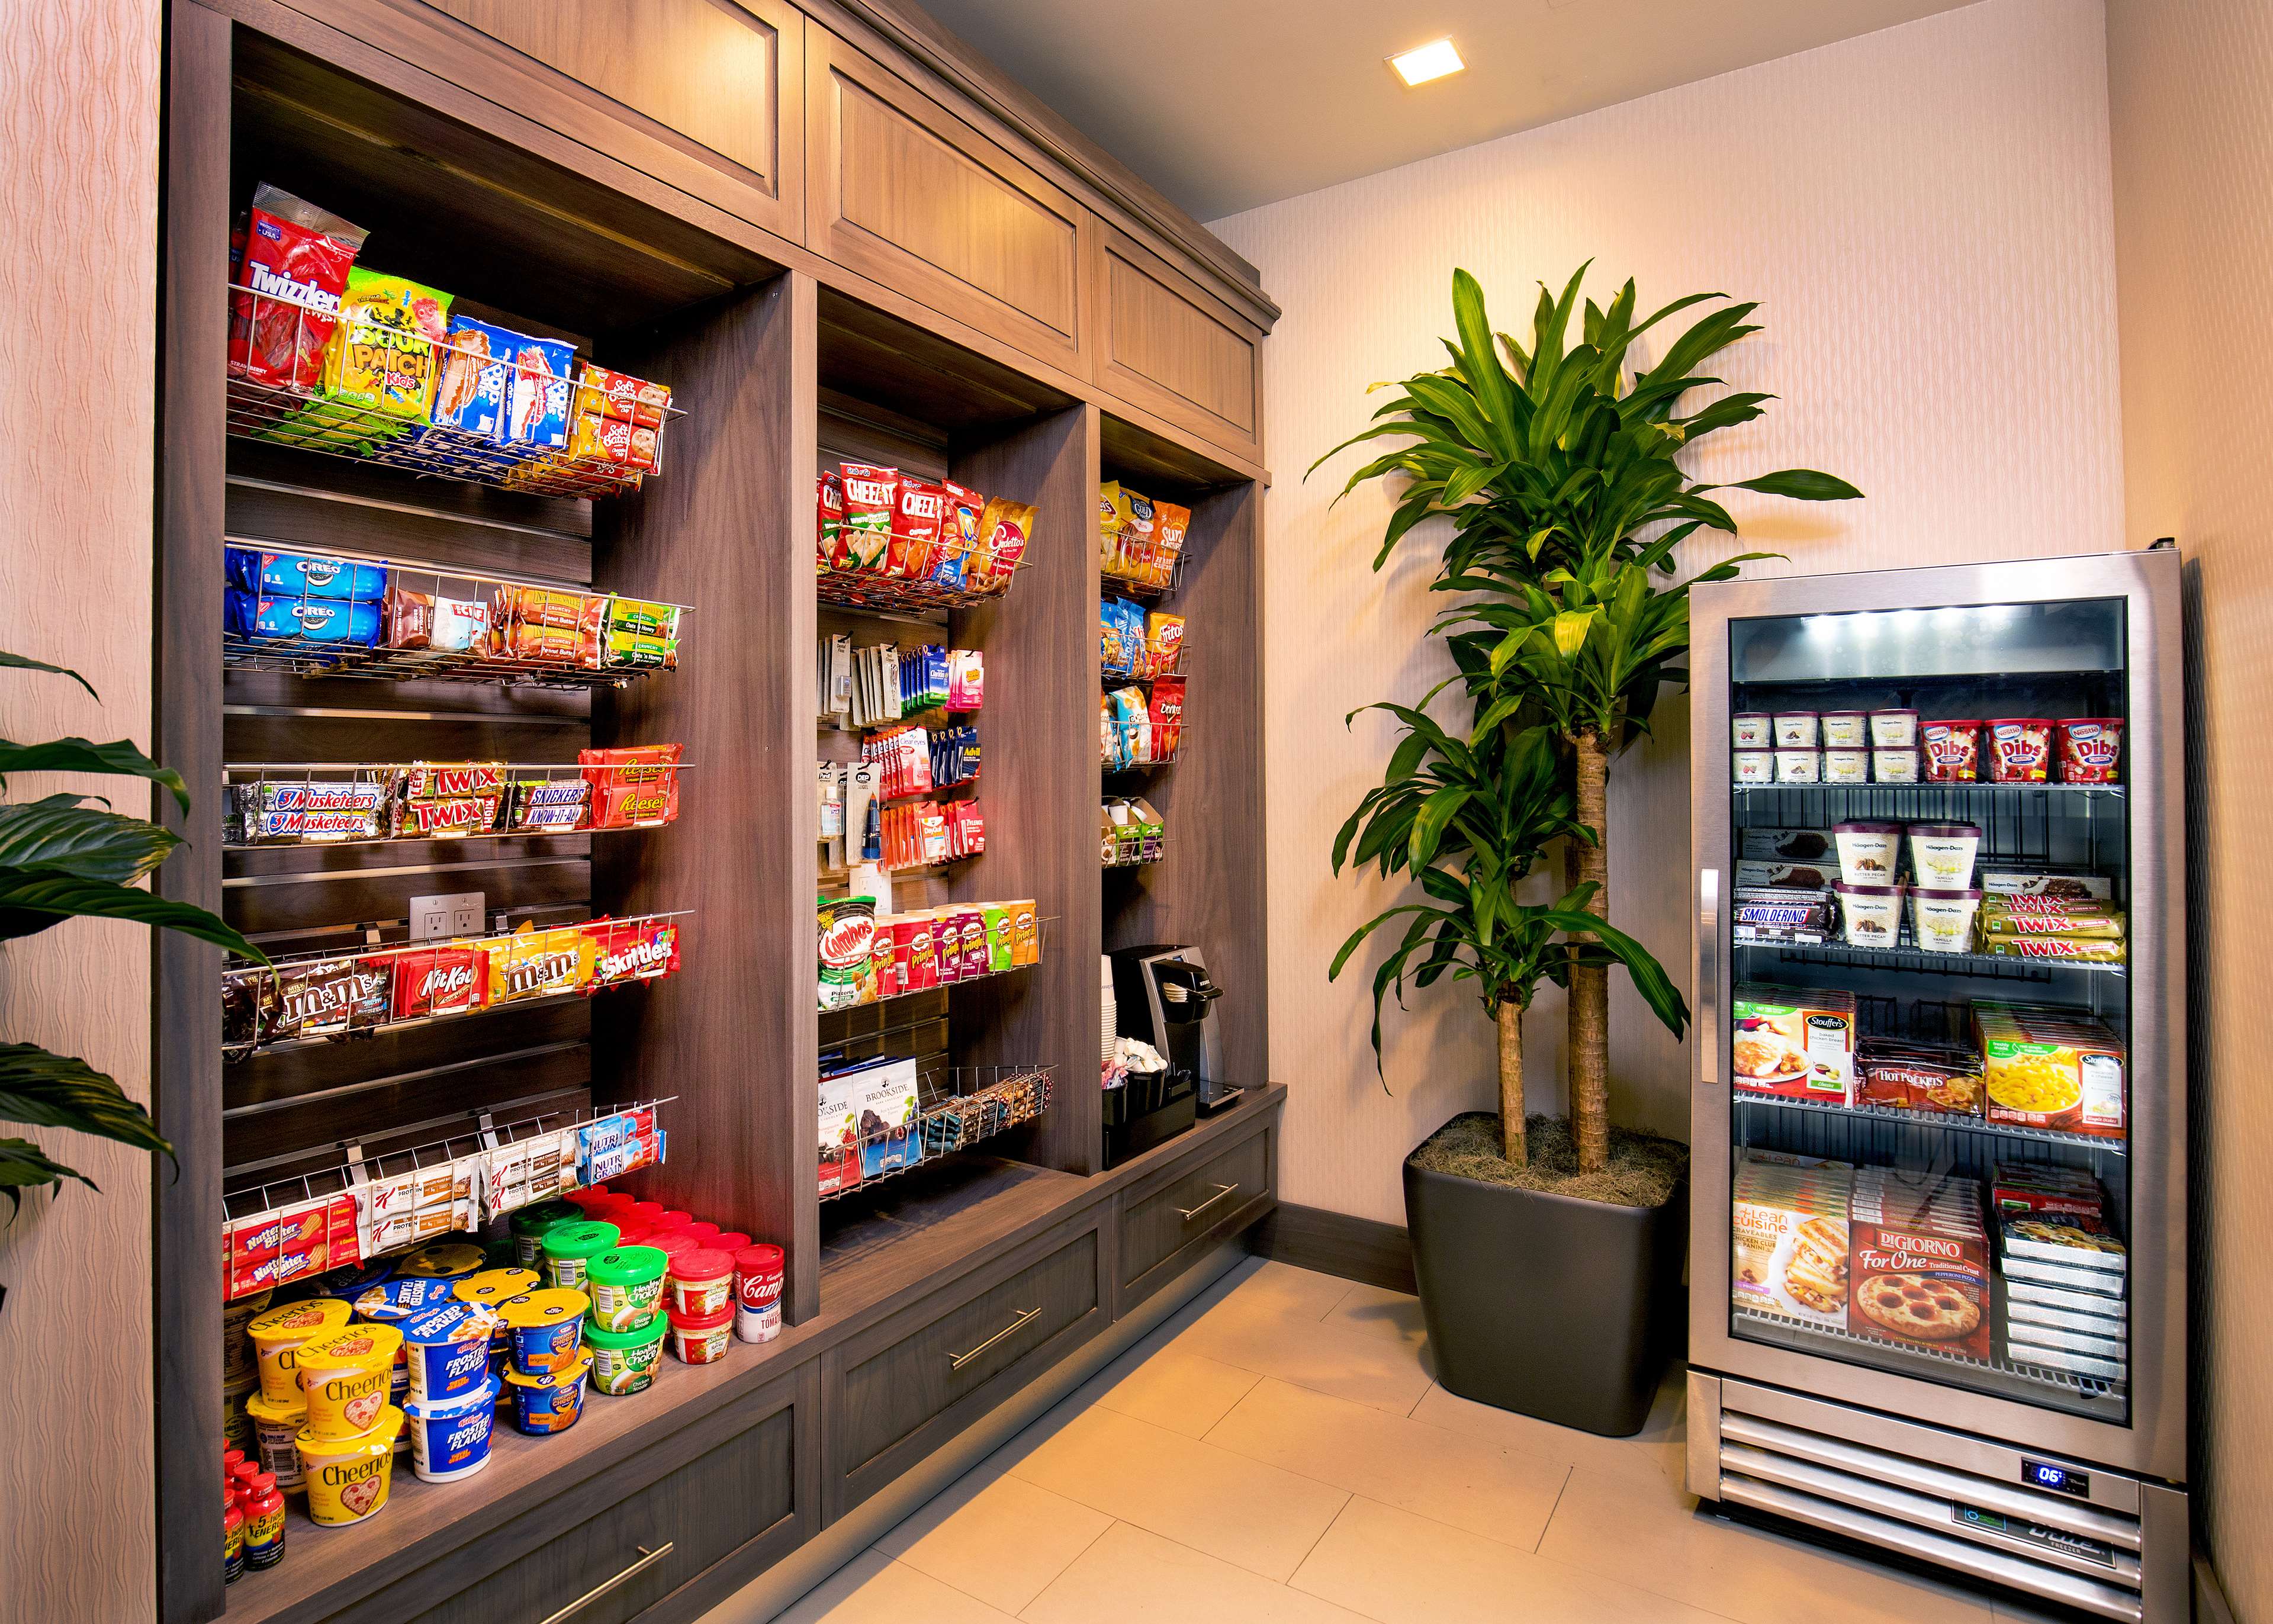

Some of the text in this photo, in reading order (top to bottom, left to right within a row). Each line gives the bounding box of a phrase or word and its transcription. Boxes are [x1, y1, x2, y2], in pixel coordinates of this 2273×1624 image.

[262, 231, 276, 239] USA
[350, 324, 429, 356] SOUR
[353, 345, 429, 377] PATCH
[387, 372, 415, 389] Kids
[616, 380, 635, 393] Soft
[607, 425, 628, 437] Soft
[1134, 503, 1152, 518] GOLD
[296, 561, 340, 575] OREO
[291, 605, 336, 618] OREO
[541, 614, 576, 625] Peanut Butter
[641, 625, 655, 633] Honey
[1159, 623, 1183, 646] Fritos
[648, 653, 662, 661] Honey
[931, 670, 945, 678] Claritin
[1161, 703, 1181, 715] Doritos
[1927, 728, 1947, 738] Nestlé
[1997, 727, 2020, 738] Nestlé
[2073, 726, 2099, 737] Nestlé
[964, 747, 980, 755] Advil
[1930, 740, 1970, 757] Dibs
[2000, 739, 2040, 757] Dibs
[2076, 739, 2118, 757] Dibs
[619, 758, 668, 776] Reese's
[428, 768, 499, 795] TWIX
[291, 791, 373, 809] Musketeers
[532, 789, 584, 803] SNICKERS
[619, 793, 665, 812] Reese's
[284, 813, 364, 829] Musketeers
[410, 803, 482, 831] TWIX
[485, 797, 495, 829] RIGHT
[2004, 894, 2064, 904] TWIX
[1742, 908, 1806, 922] SMOLDERING
[2003, 903, 2064, 914] TWIX
[2009, 915, 2072, 933] TWIX
[825, 921, 872, 958] Combos
[962, 936, 985, 952] Pringles
[2012, 937, 2076, 957] TWIX
[602, 942, 672, 980] Skittles
[971, 951, 985, 960] BBQ
[288, 983, 304, 991] MILK
[1811, 1017, 1843, 1028] Stouffer's
[1880, 1070, 1943, 1086] HOT POCKETS
[866, 1083, 909, 1102] BROOKSIDE
[589, 1134, 618, 1152] NUTRI
[398, 1187, 422, 1197] PROTIN
[1751, 1210, 1787, 1224] Lean
[247, 1224, 279, 1250] Nutter
[1743, 1242, 1765, 1251] PANINI
[253, 1254, 287, 1280] Nutter
[1859, 1250, 1980, 1276] For One Traditional Crust
[630, 1279, 661, 1294] Healthy
[1742, 1284, 1763, 1292] PROTEIN
[627, 1288, 658, 1303] Choice
[248, 1299, 324, 1332] Cheerios
[412, 1305, 462, 1337] FROSTED
[634, 1316, 651, 1324] Chicken
[422, 1311, 464, 1338] FLAKES
[296, 1324, 377, 1358] Cheerios
[445, 1342, 487, 1371] FROSTED
[626, 1350, 657, 1366] Choice
[630, 1343, 659, 1357] Healthy
[449, 1353, 485, 1378] FLAKES
[326, 1365, 392, 1401] Cheerios
[633, 1378, 650, 1388] Chicken
[447, 1414, 490, 1443] FROSTED
[450, 1427, 486, 1451] FLAKES
[323, 1450, 391, 1486] Cheerios
[2051, 1542, 2081, 1554] FREEZER
